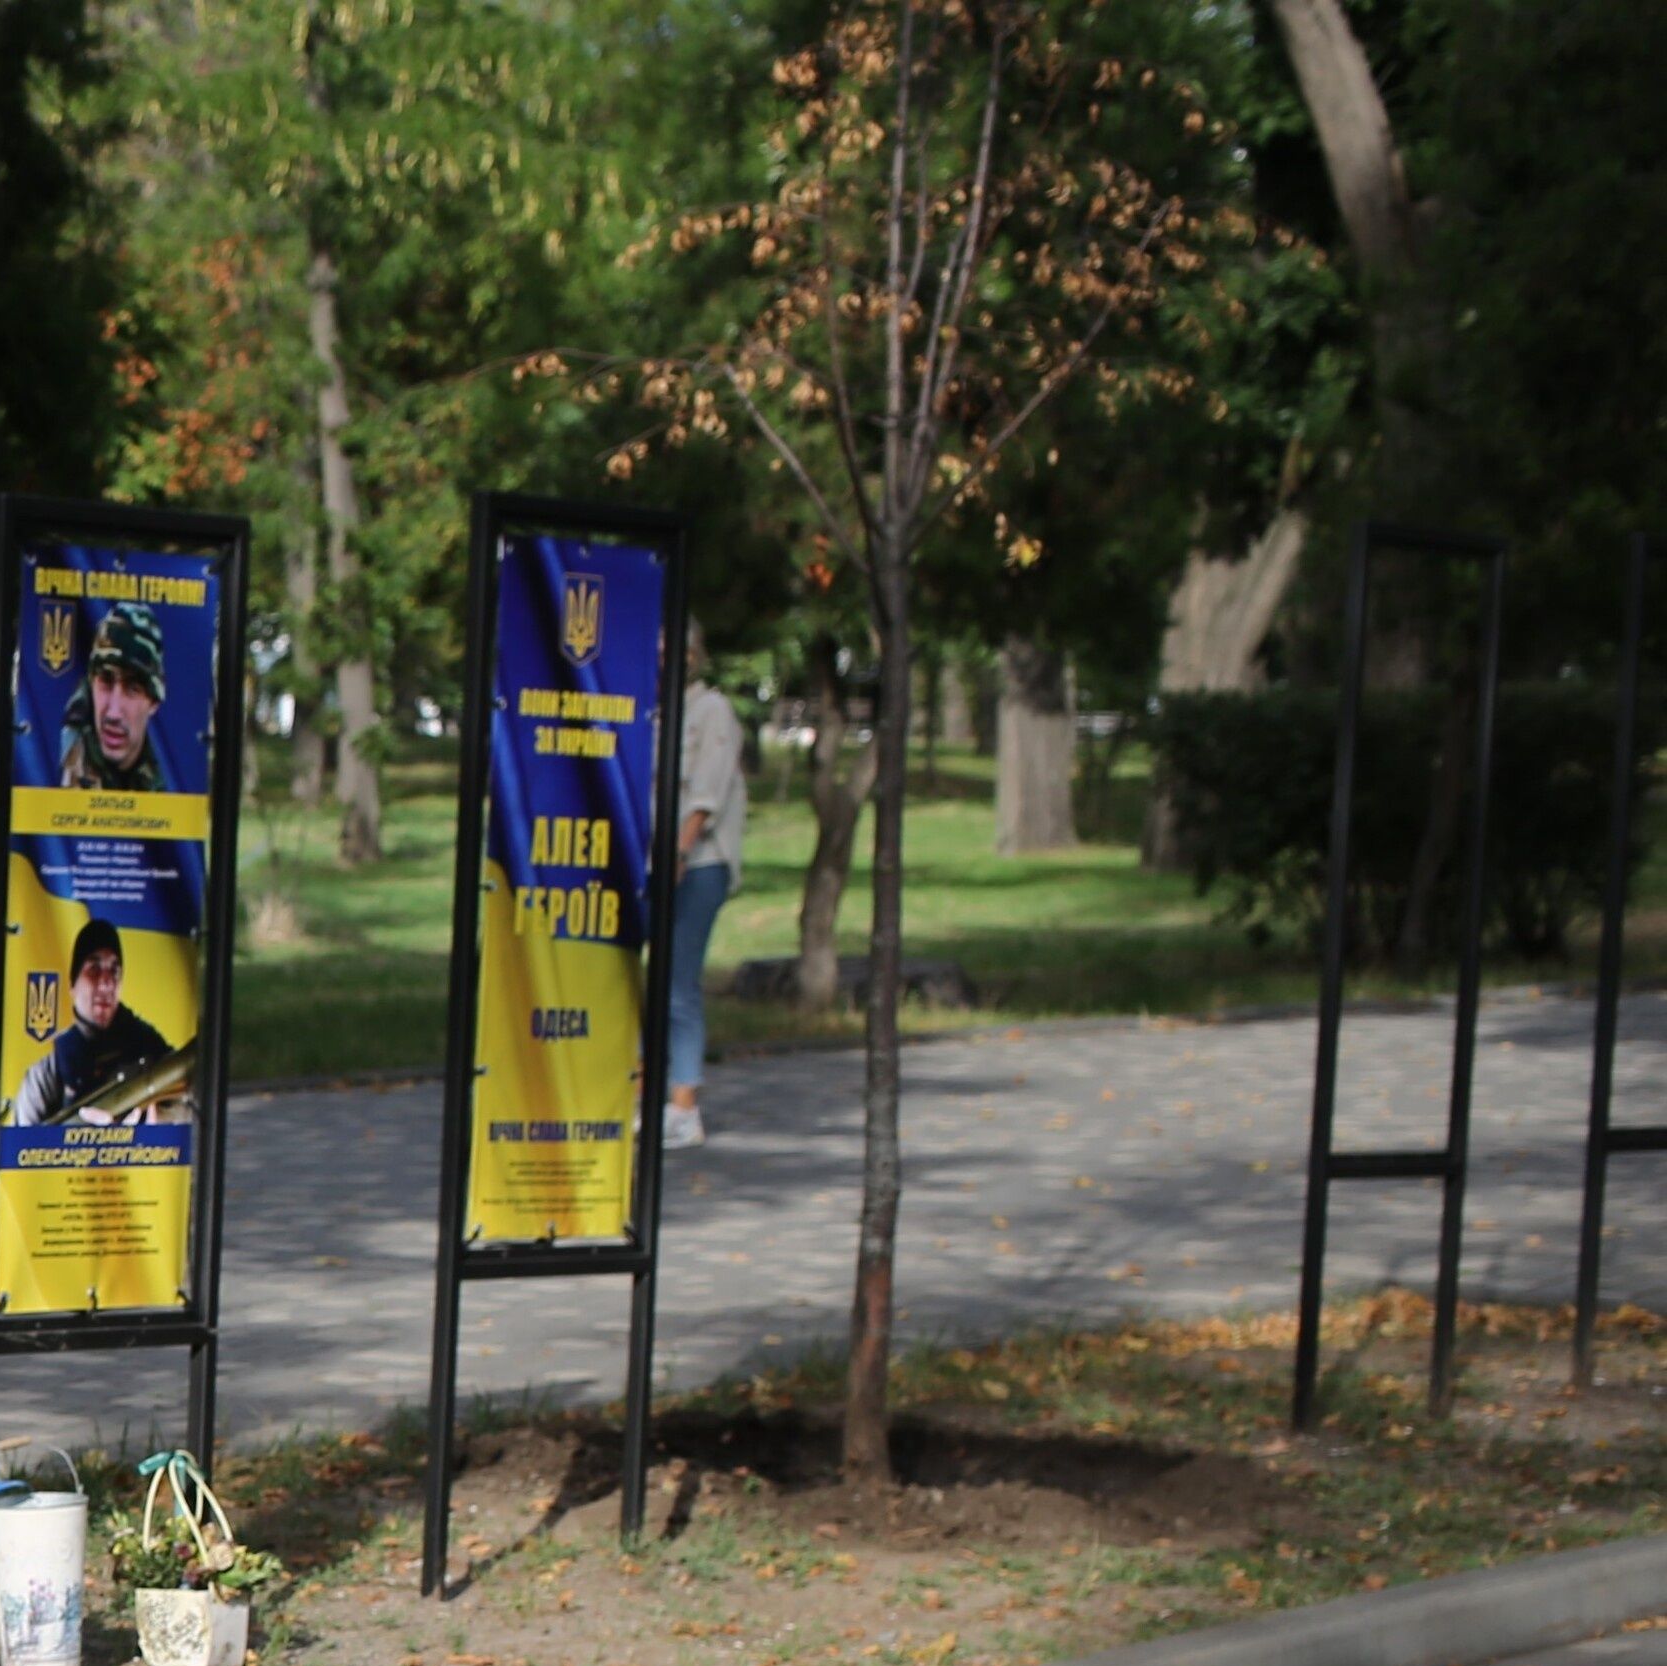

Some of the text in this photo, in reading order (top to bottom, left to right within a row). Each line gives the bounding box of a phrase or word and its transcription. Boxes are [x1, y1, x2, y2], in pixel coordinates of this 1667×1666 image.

[530, 816, 610, 868] АЛЕЯ
[514, 880, 620, 939] ГЕРОЇВ
[531, 1007, 589, 1041] ОДЕСА
[18, 1147, 97, 1167] ОЛЕКСАНДР
